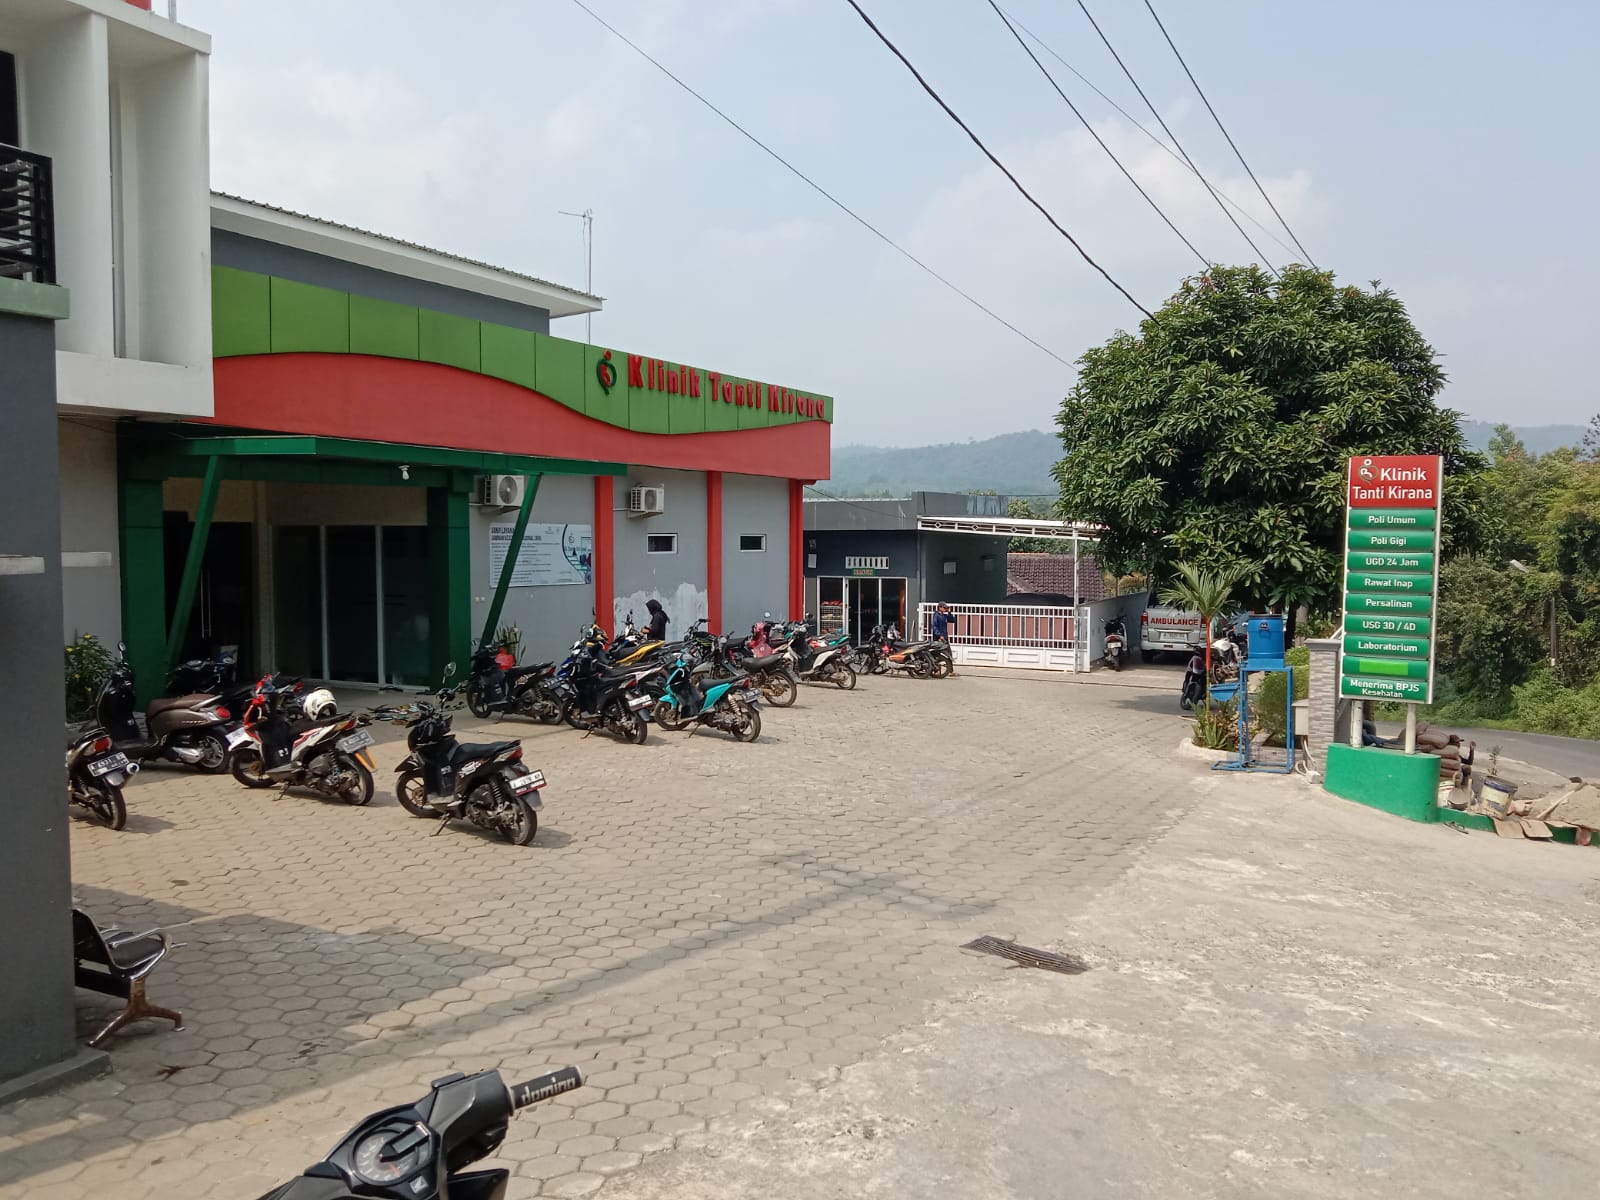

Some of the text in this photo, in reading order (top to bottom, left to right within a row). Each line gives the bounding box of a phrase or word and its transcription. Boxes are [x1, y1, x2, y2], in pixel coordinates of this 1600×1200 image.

[628, 353, 824, 418] Klinik Tanti Kirana
[1381, 467, 1427, 481] Klinik
[1352, 486, 1433, 499] Tanti Kirana
[1368, 515, 1416, 524] Poli Umum
[1371, 537, 1407, 546] Poli Gigi
[1365, 557, 1419, 566] UGD 24 Jam
[1364, 578, 1413, 589] Rawat Inap
[1365, 598, 1413, 608] Persalinan
[1151, 617, 1199, 625] AMBULANCE
[1362, 620, 1416, 631] USG 3D / 4D
[1358, 641, 1418, 652] Laboratorium
[1350, 679, 1420, 692] Menerima BPJS
[1362, 688, 1403, 698] Kesehatan
